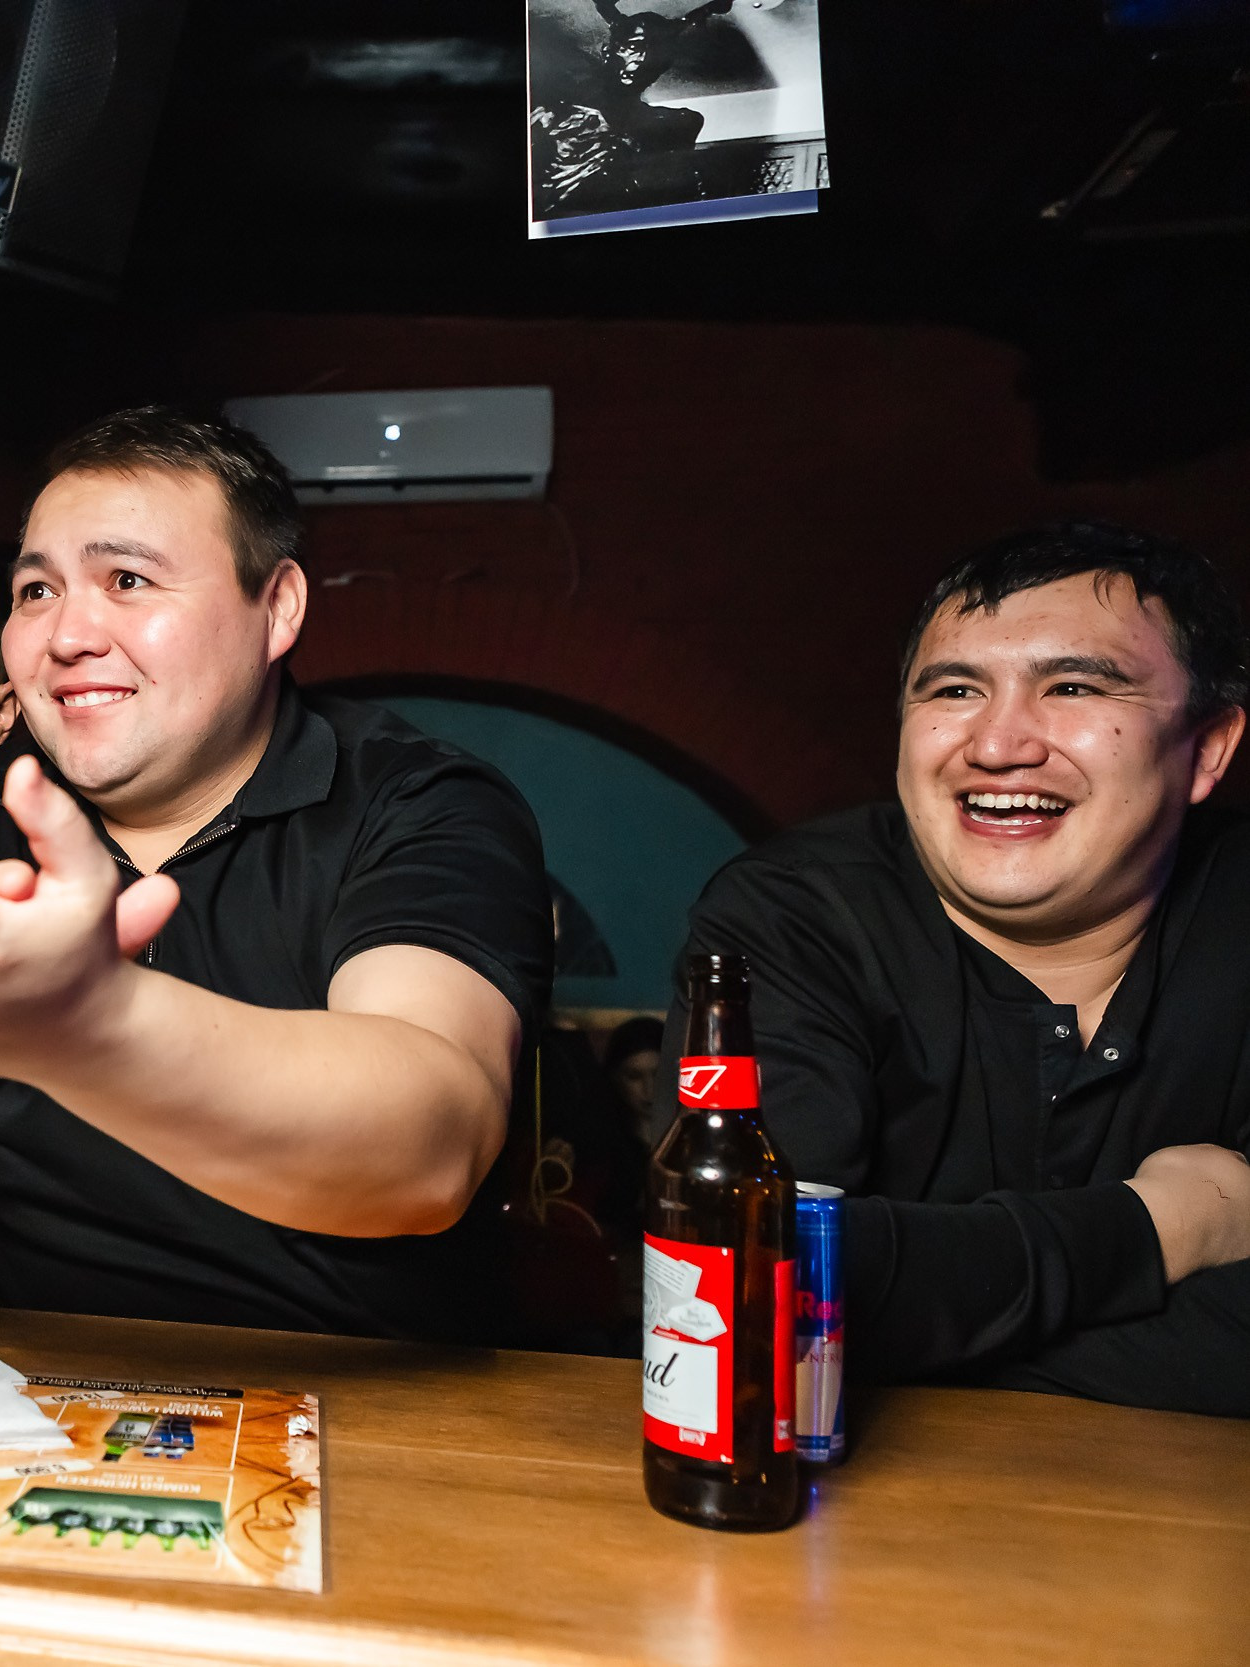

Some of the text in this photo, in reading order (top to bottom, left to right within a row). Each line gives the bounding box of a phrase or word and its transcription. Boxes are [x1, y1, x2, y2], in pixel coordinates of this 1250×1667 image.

[644, 1352, 680, 1388] ud
[162, 1407, 224, 1418] WILLIAM
[56, 1475, 138, 1490] HEINEKEN
